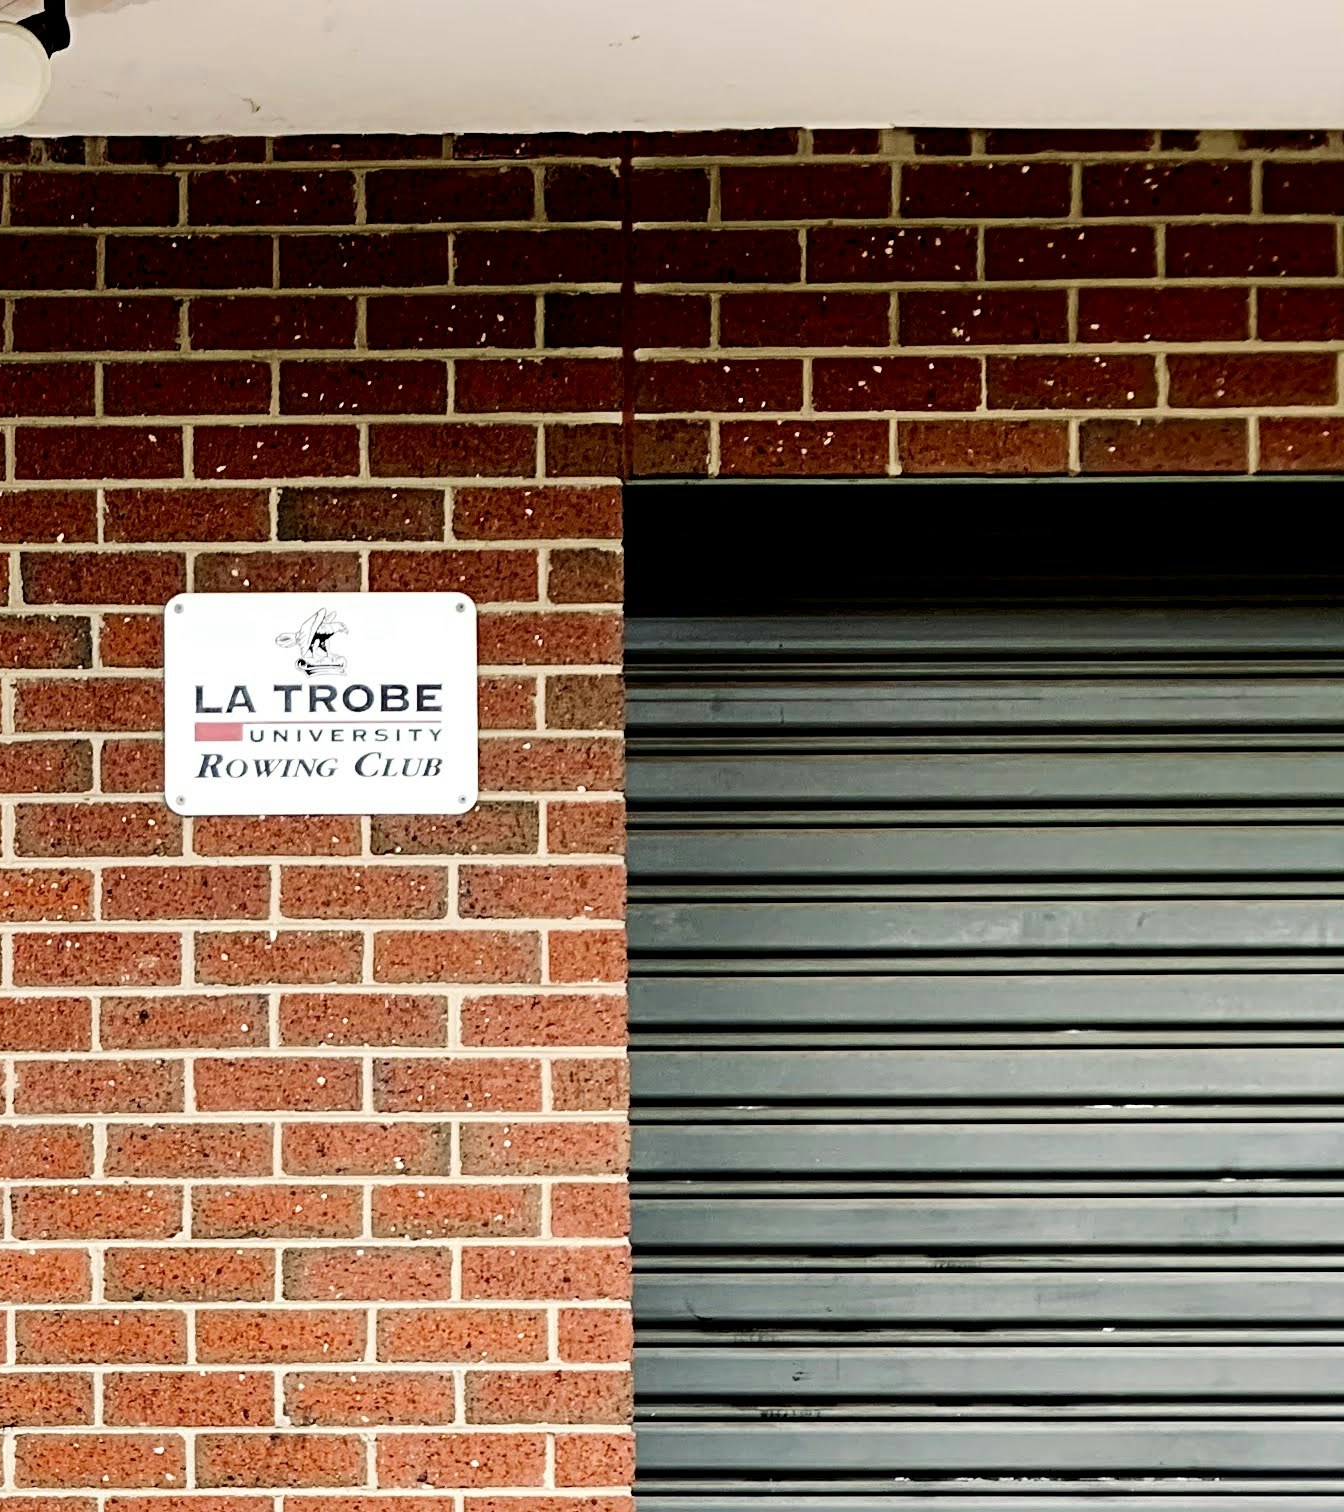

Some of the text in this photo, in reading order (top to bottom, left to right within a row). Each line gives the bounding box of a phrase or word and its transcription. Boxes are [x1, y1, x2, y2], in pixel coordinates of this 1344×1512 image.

[194, 683, 443, 714] LA TROBE
[249, 728, 443, 743] UNIVERSITY
[194, 751, 443, 779] ROWING CLUB
